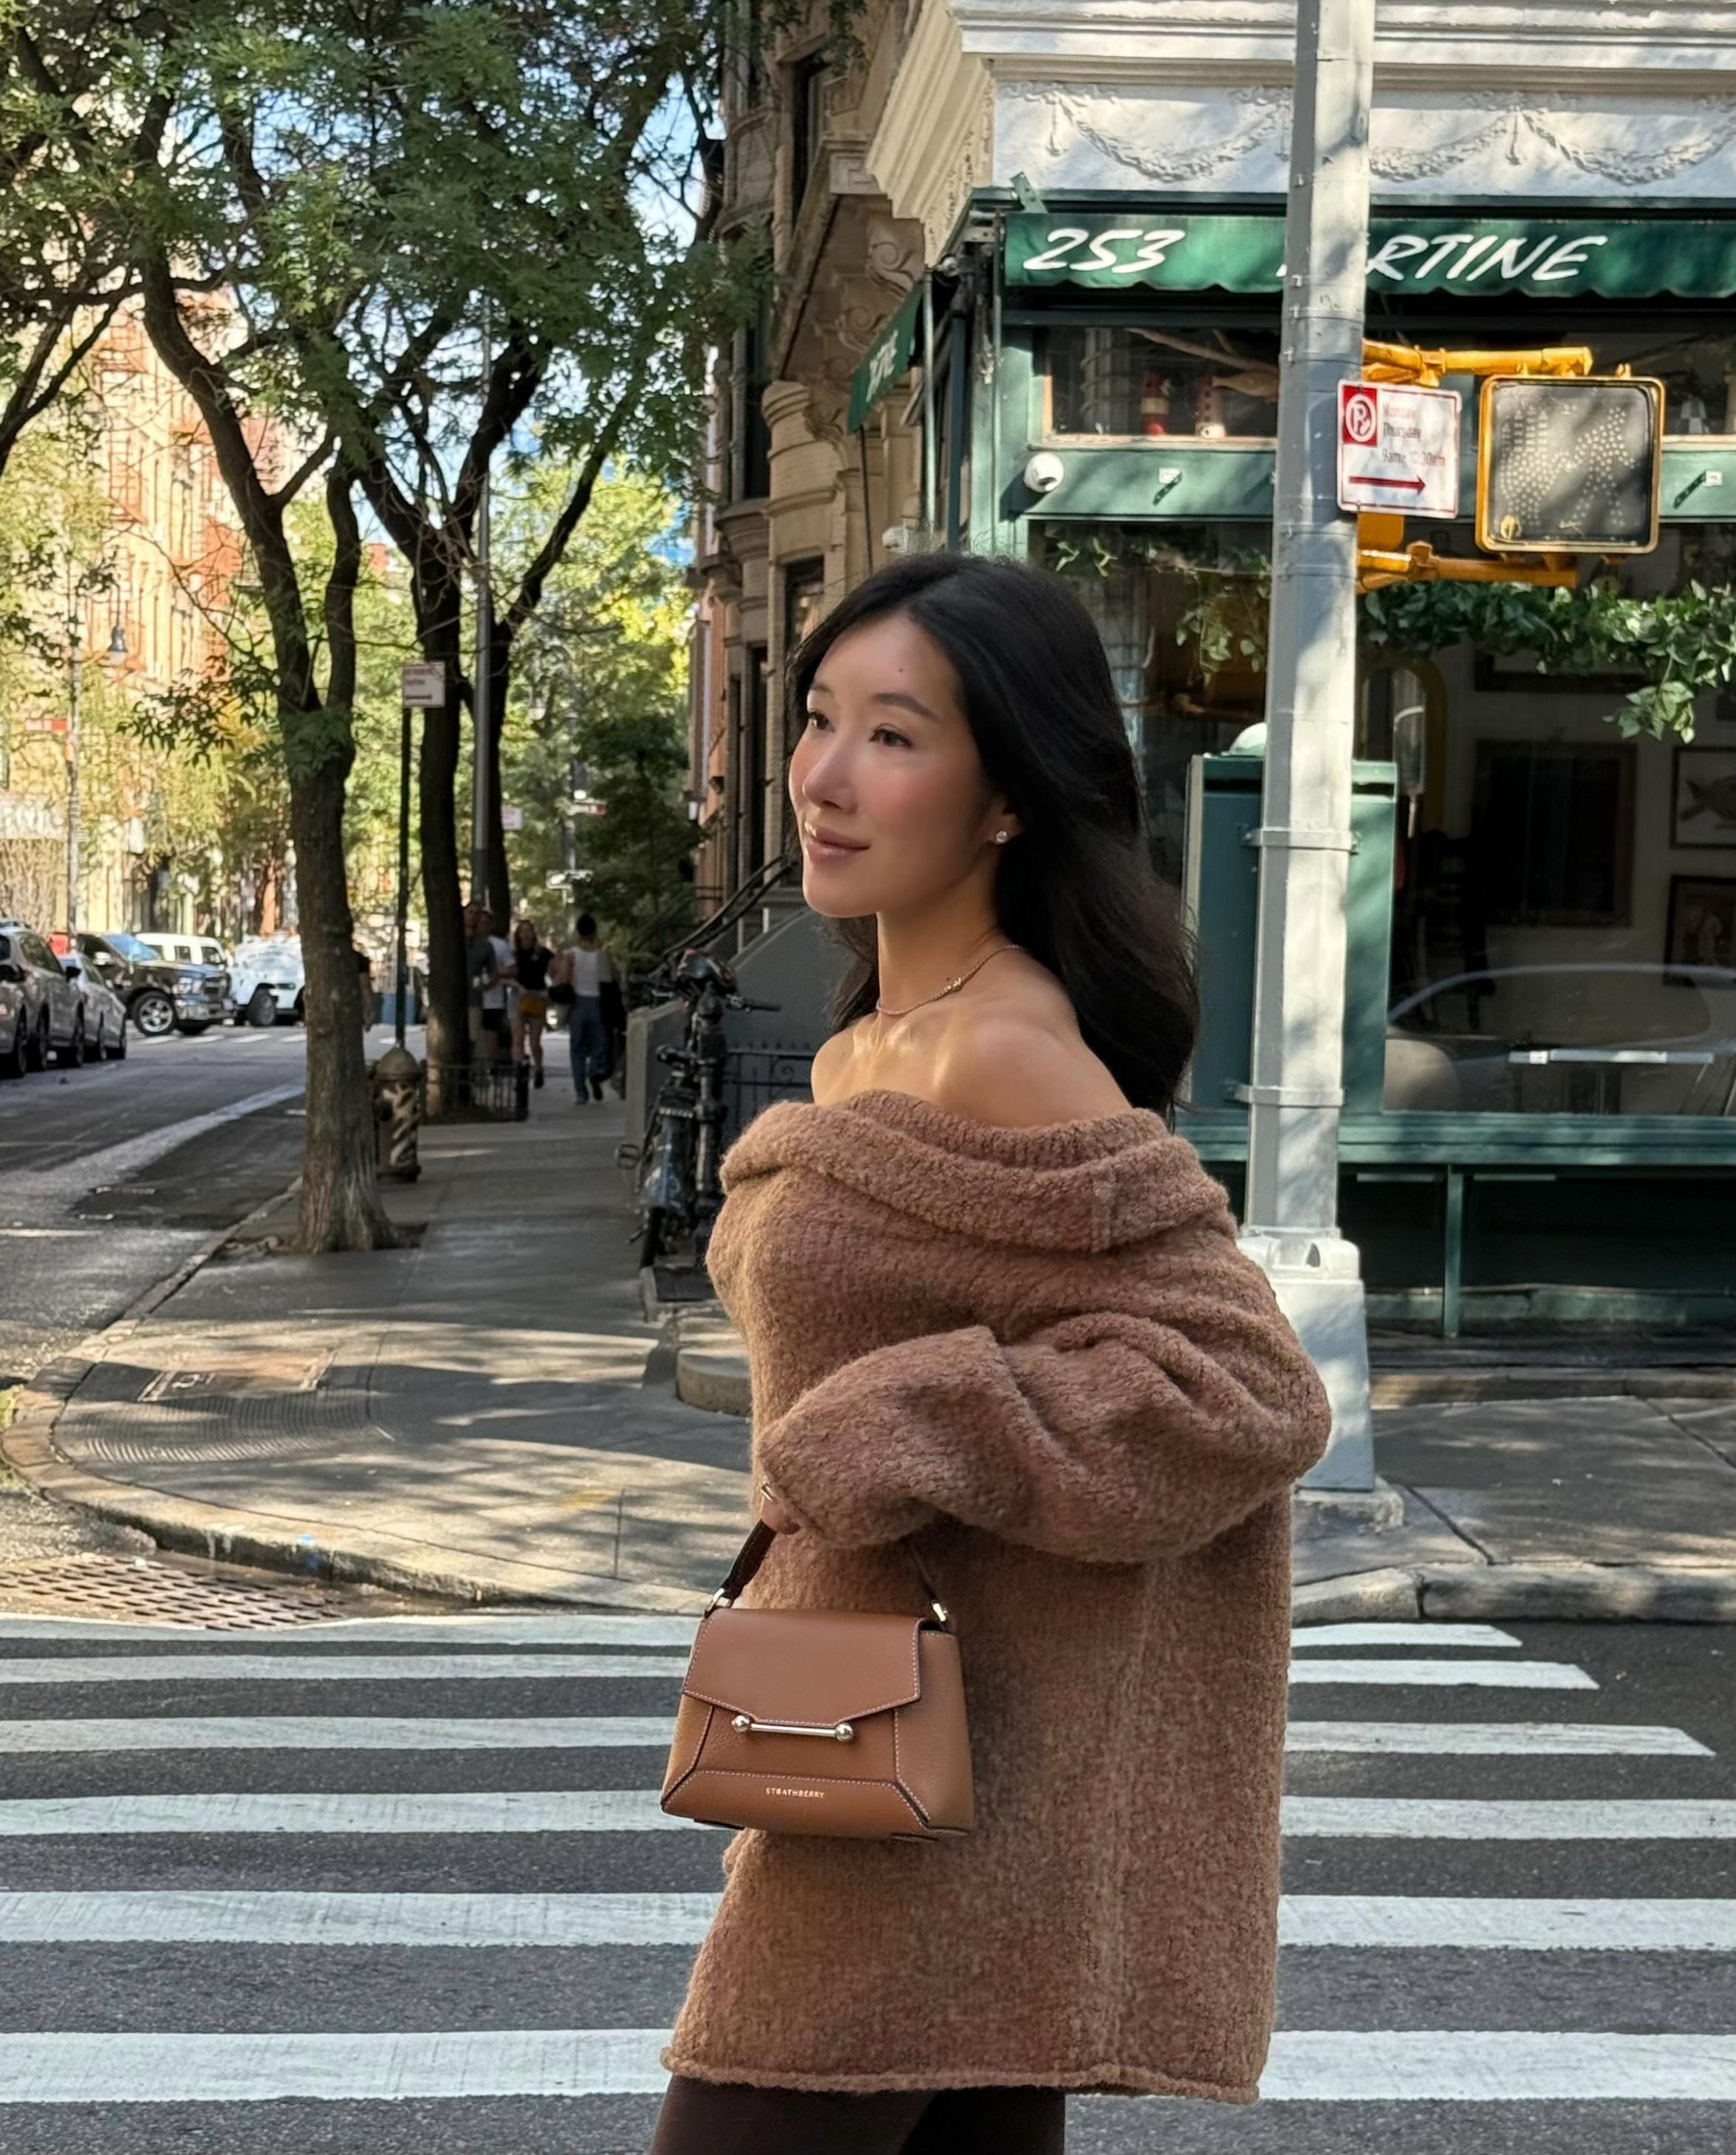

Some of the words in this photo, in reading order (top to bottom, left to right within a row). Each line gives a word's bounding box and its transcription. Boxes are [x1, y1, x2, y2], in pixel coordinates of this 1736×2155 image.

[1023, 228, 1185, 273] 253
[1276, 233, 1608, 281] RTINE
[1383, 422, 1421, 443] Thursday
[765, 1787, 826, 1798] STRATHBERRY
